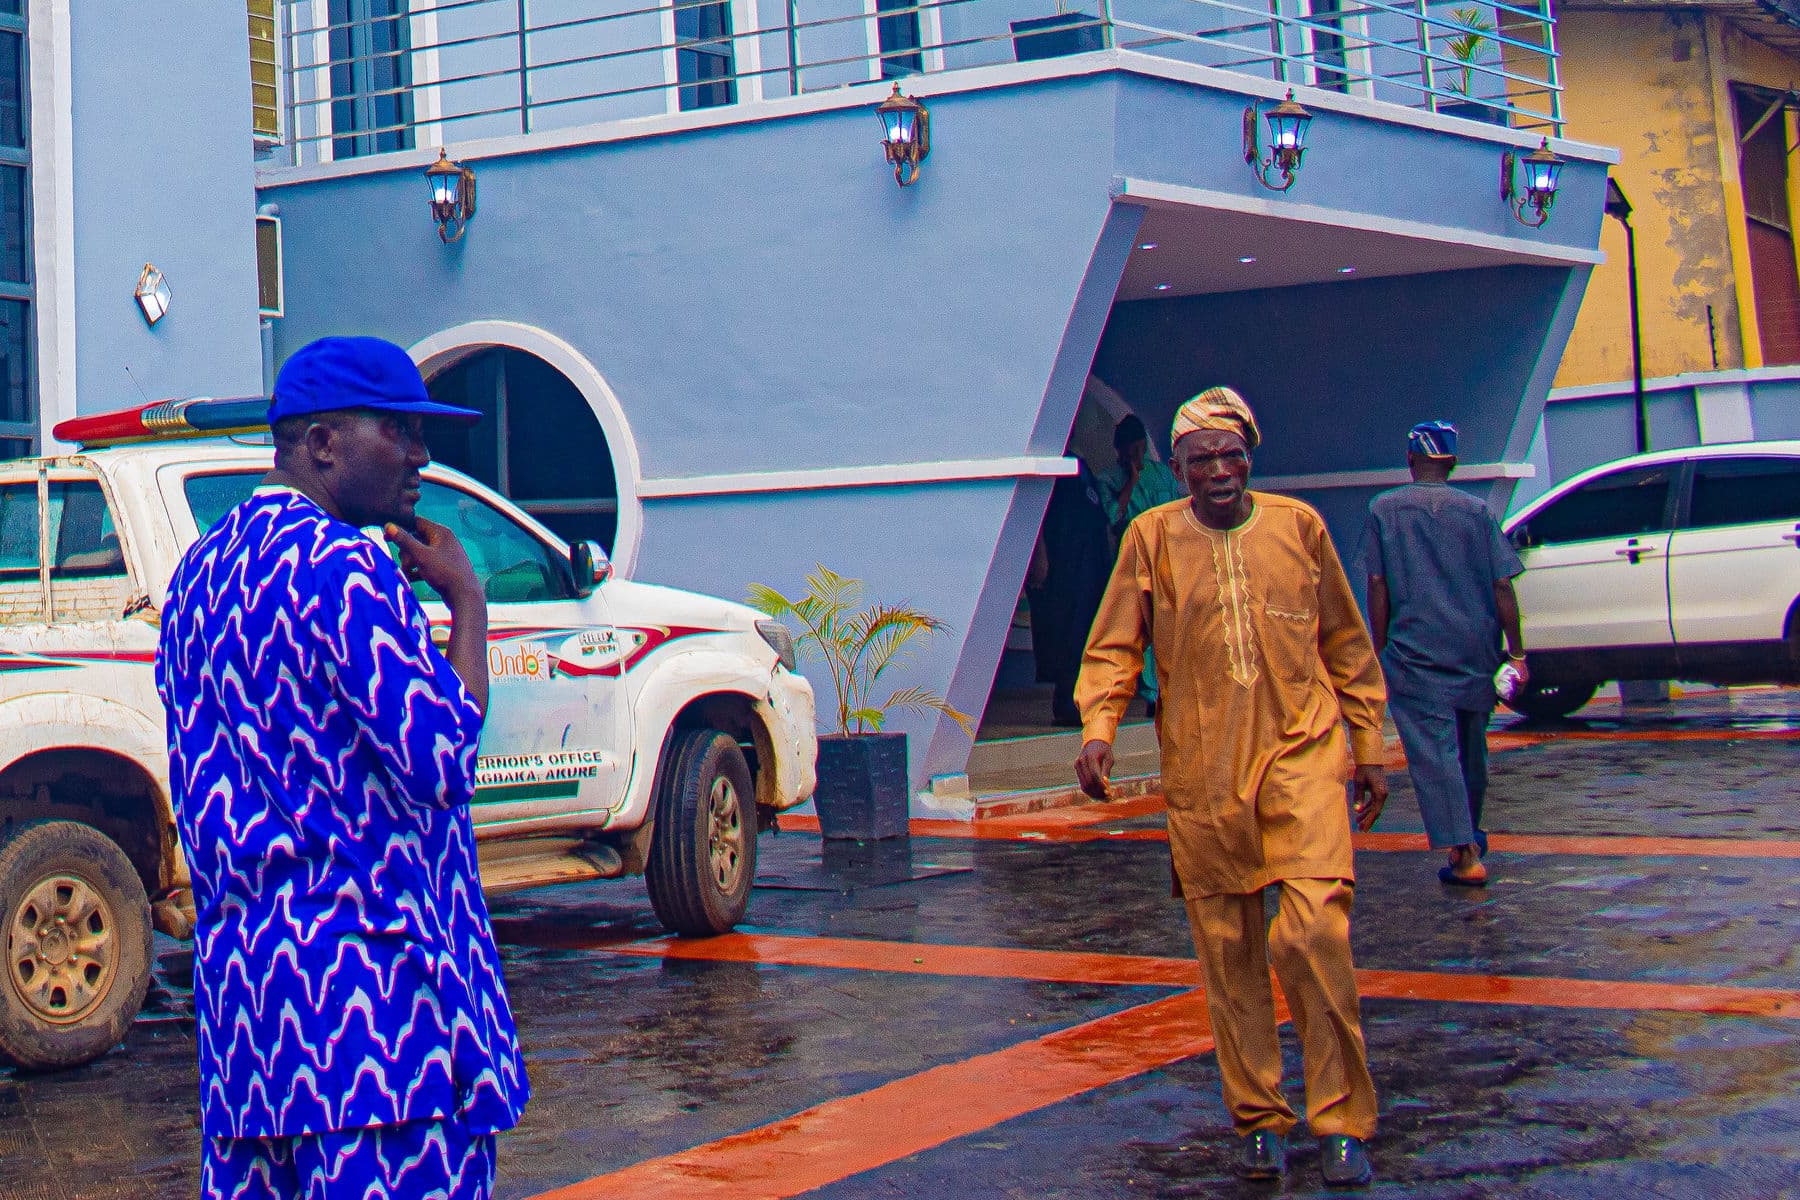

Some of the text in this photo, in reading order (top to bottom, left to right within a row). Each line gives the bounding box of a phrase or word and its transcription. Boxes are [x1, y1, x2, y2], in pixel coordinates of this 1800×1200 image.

[489, 643, 540, 676] Ondo
[476, 751, 602, 769] ERNOR'S OFFICE
[545, 765, 598, 779] AKURE
